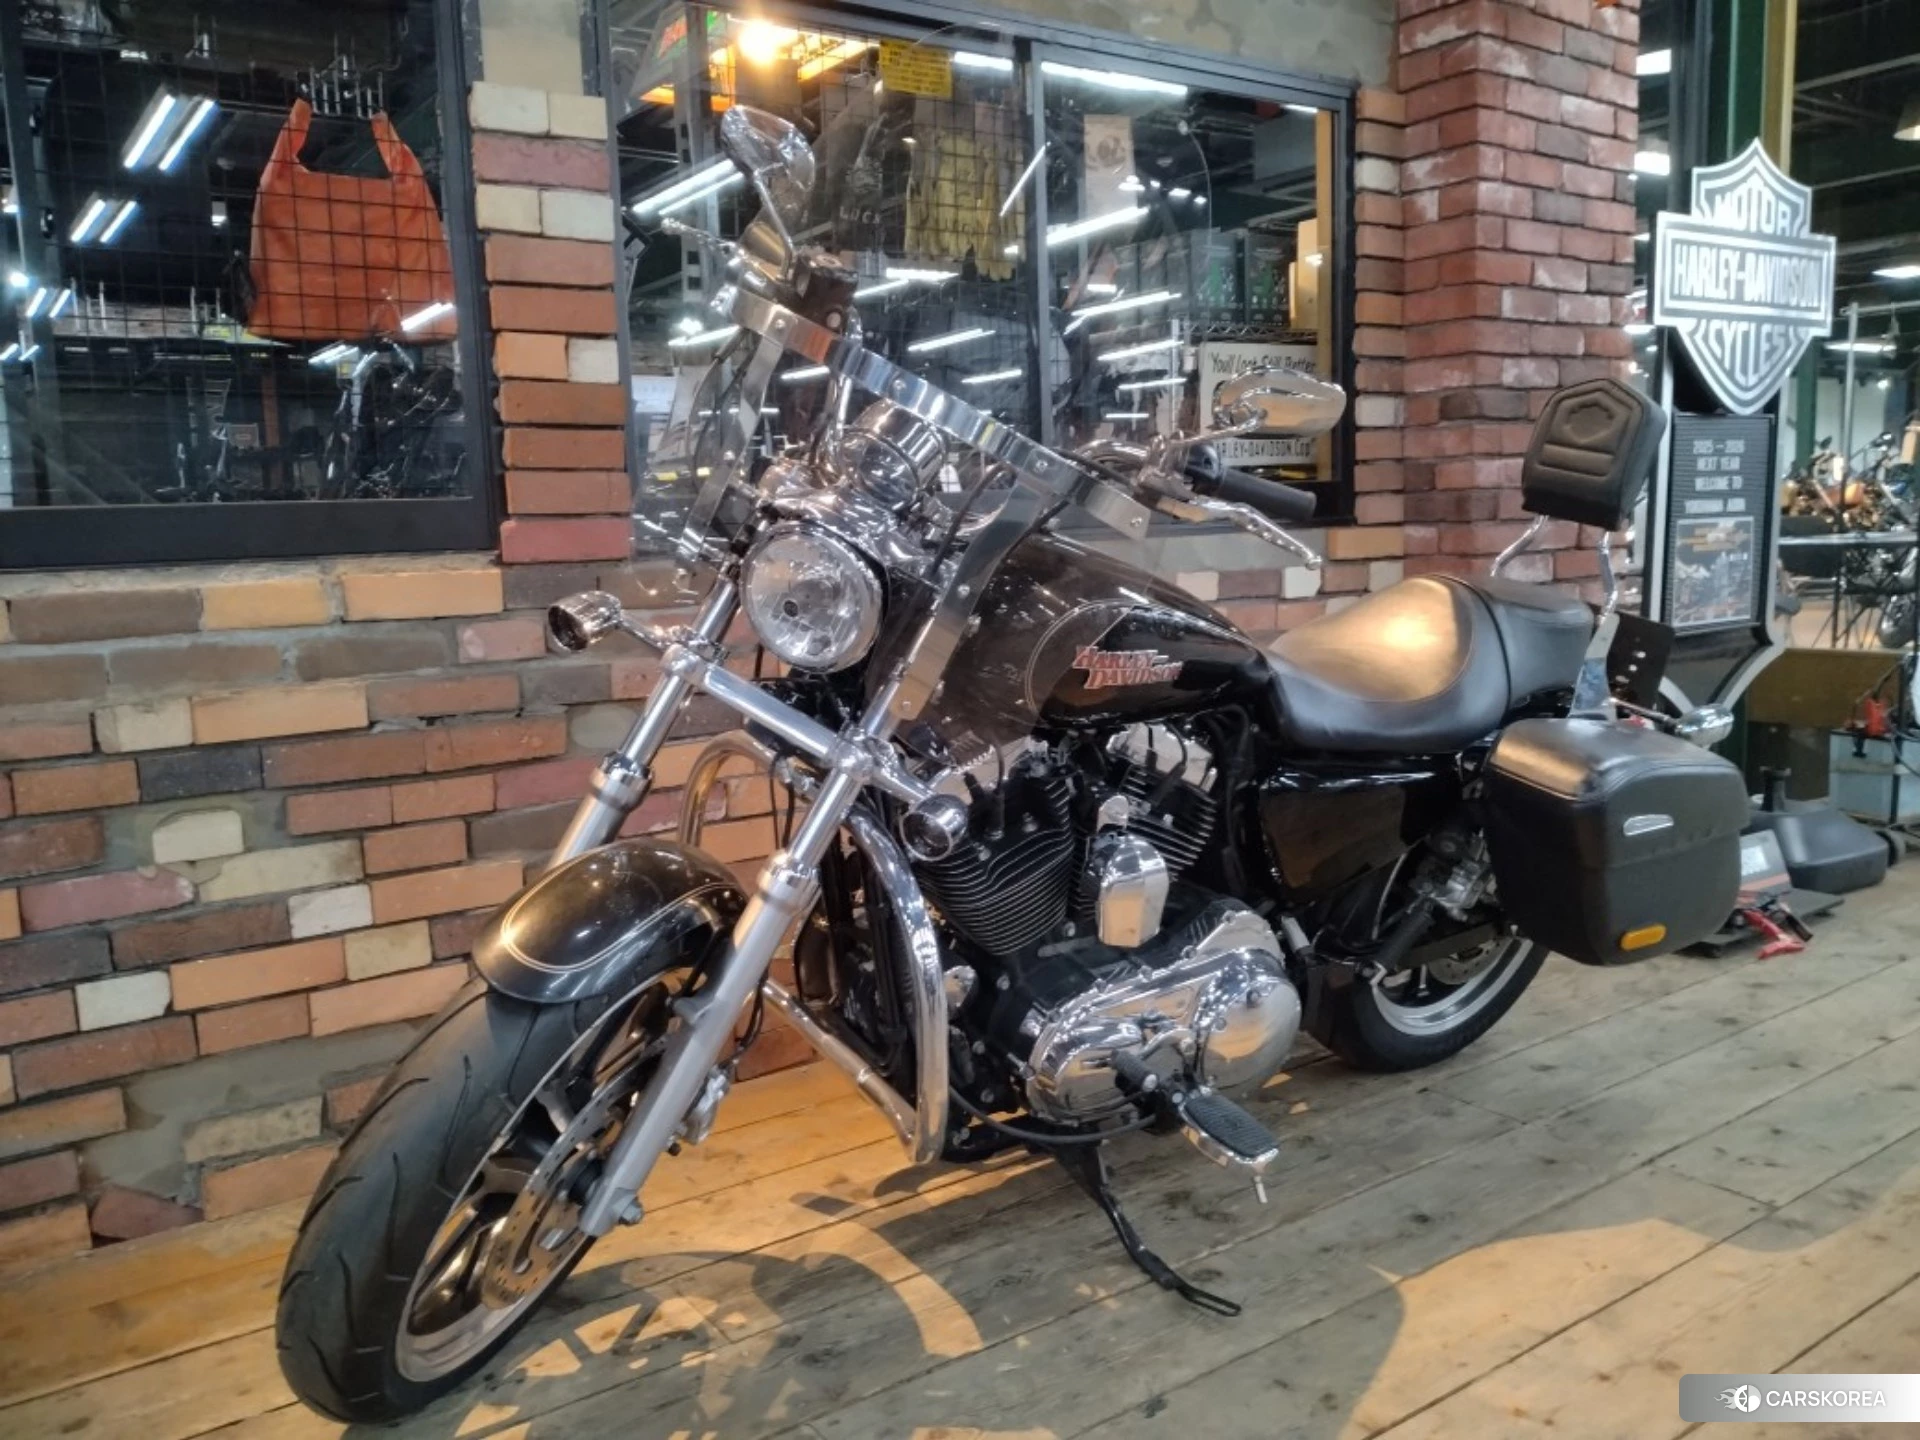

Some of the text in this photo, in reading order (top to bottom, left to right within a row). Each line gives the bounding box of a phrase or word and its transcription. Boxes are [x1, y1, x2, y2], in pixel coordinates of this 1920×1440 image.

[1709, 172, 1792, 236] MOTOR
[1673, 243, 1821, 309] HARLEY-DAVIDSON
[1708, 319, 1788, 387] CYCLES
[1216, 440, 1293, 457] ARLEY-DAVIDSON
[1083, 660, 1184, 689] DAVIDSON
